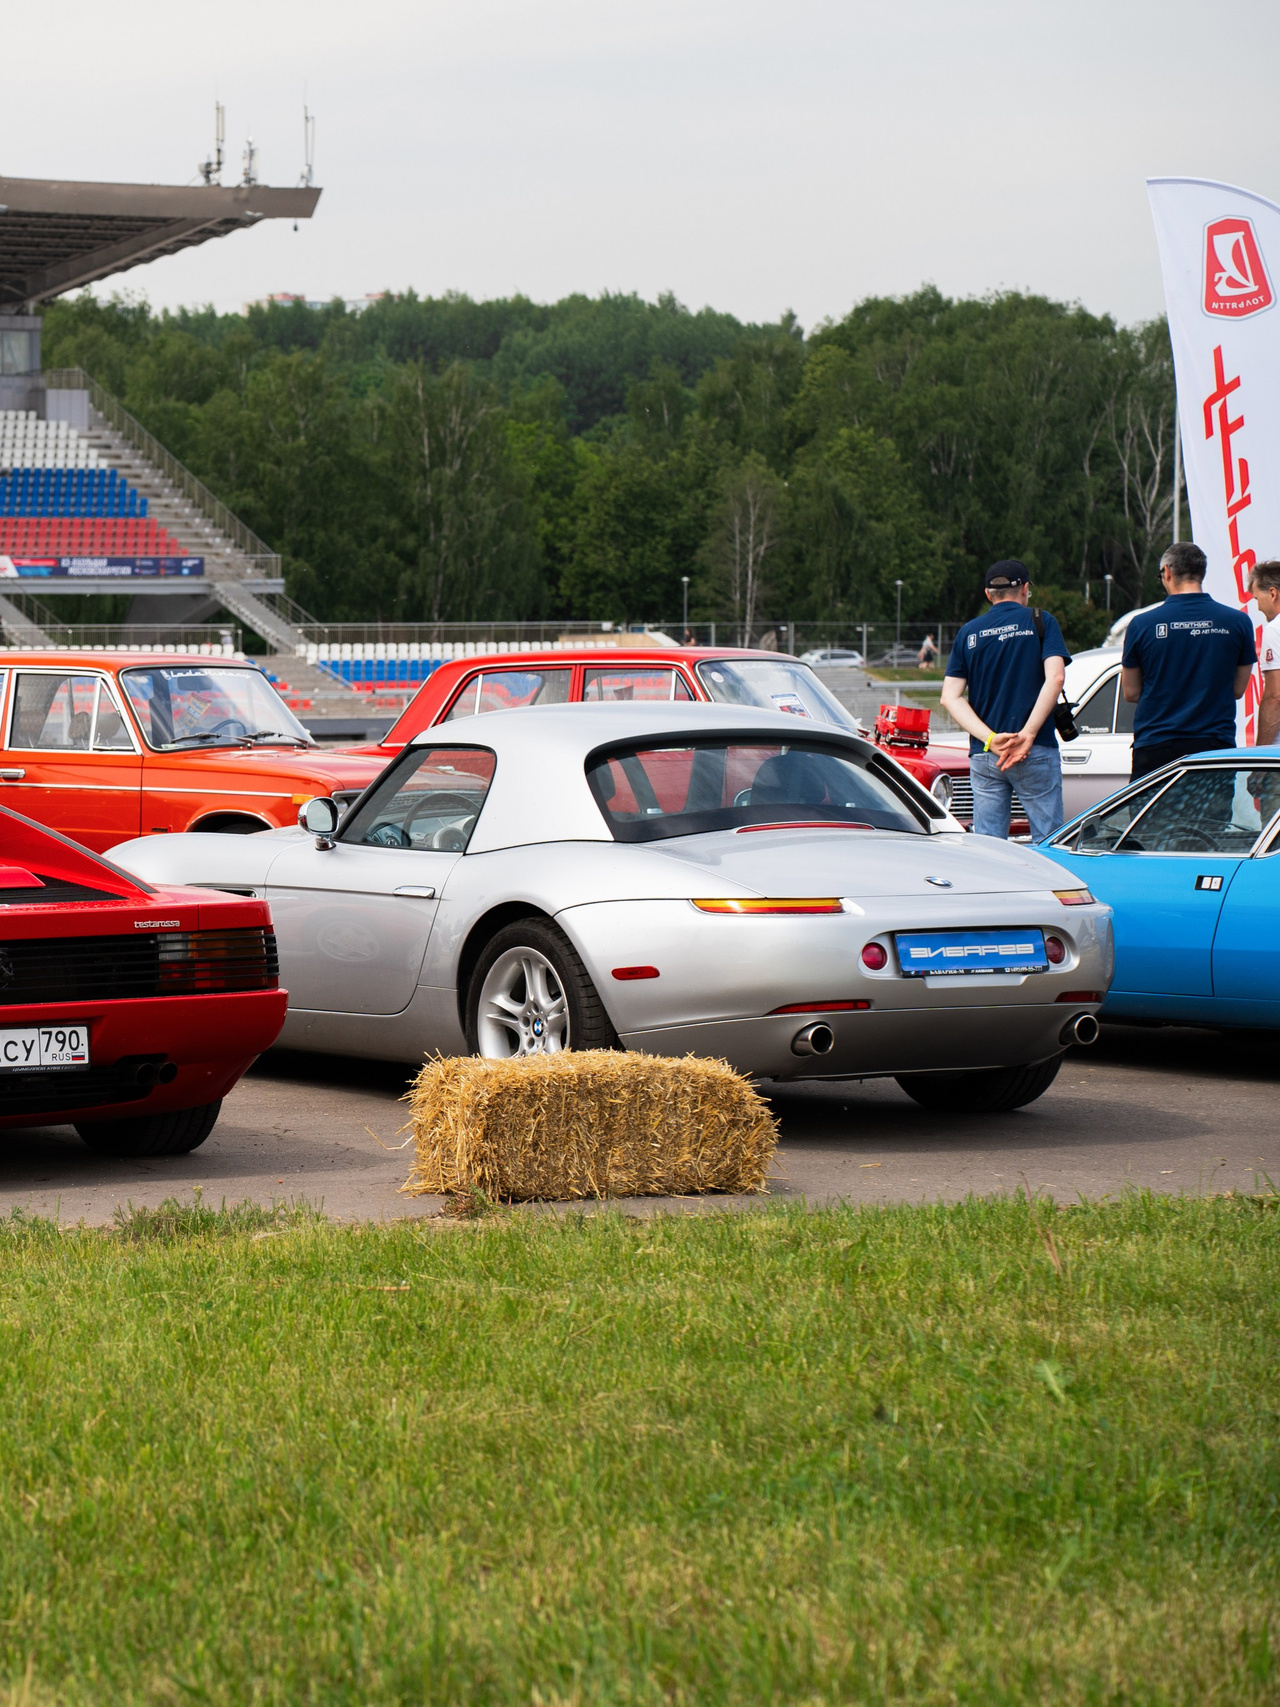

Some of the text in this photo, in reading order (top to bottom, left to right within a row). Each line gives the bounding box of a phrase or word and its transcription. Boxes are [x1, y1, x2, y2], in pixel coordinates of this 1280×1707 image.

[134, 920, 180, 928] testarossa
[41, 1030, 80, 1053] 790
[52, 1052, 71, 1062] RUS
